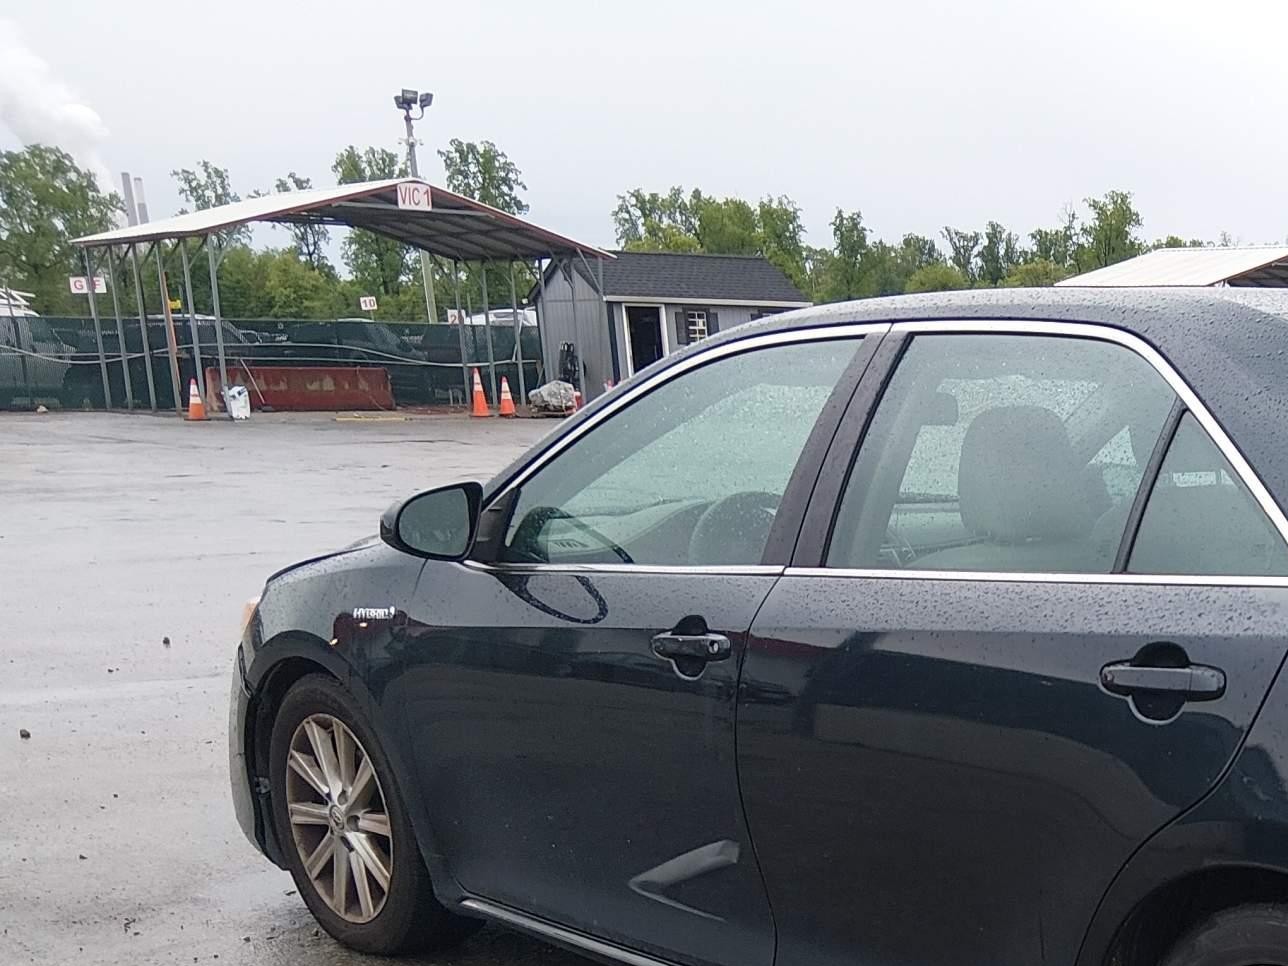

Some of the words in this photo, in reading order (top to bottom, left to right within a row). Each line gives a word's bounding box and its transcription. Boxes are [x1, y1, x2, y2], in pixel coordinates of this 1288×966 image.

[399, 186, 420, 206] VIC
[423, 188, 430, 206] 1
[73, 279, 84, 290] G
[362, 299, 376, 308] 10
